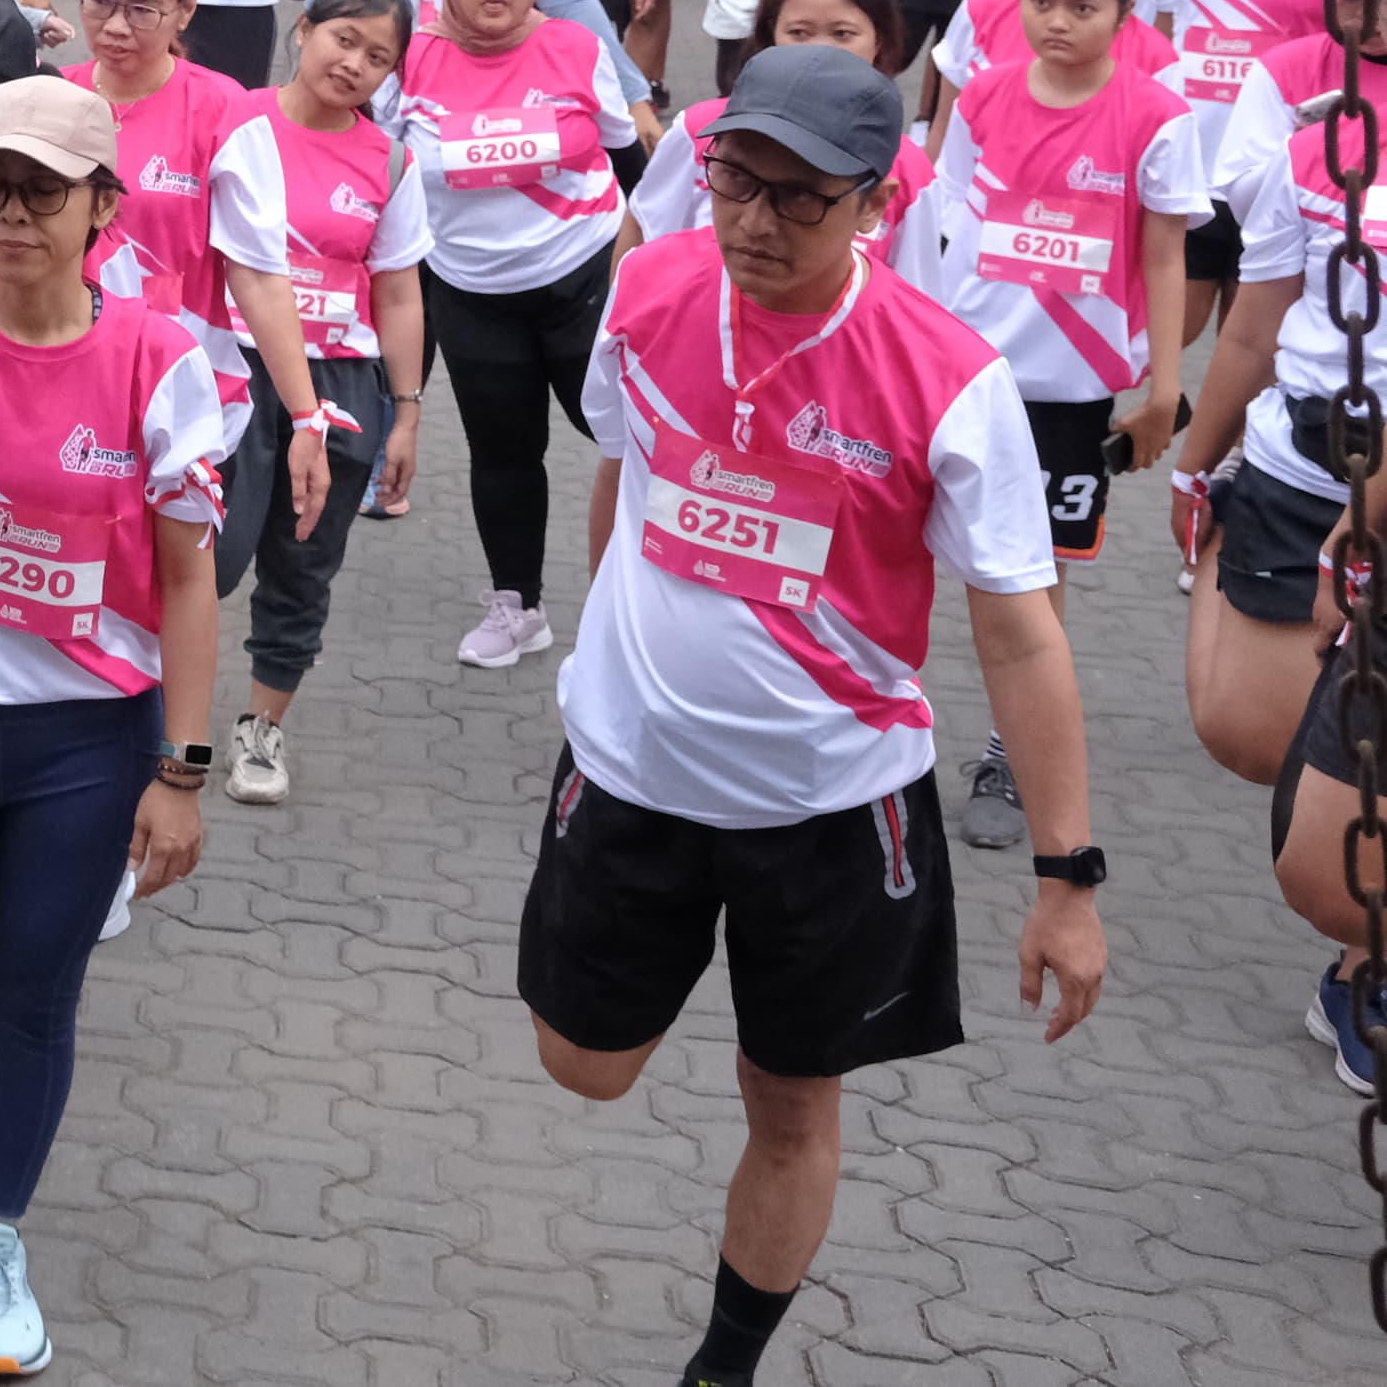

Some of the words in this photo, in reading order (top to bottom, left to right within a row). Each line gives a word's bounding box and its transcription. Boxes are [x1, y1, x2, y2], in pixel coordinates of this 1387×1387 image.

[466, 141, 537, 164] 6200
[1012, 233, 1081, 263] 6201
[824, 429, 892, 463] smartfren
[716, 471, 774, 492] smartfren
[13, 525, 61, 545] smartfren
[677, 499, 781, 556] 6251
[785, 586, 802, 598] 5K
